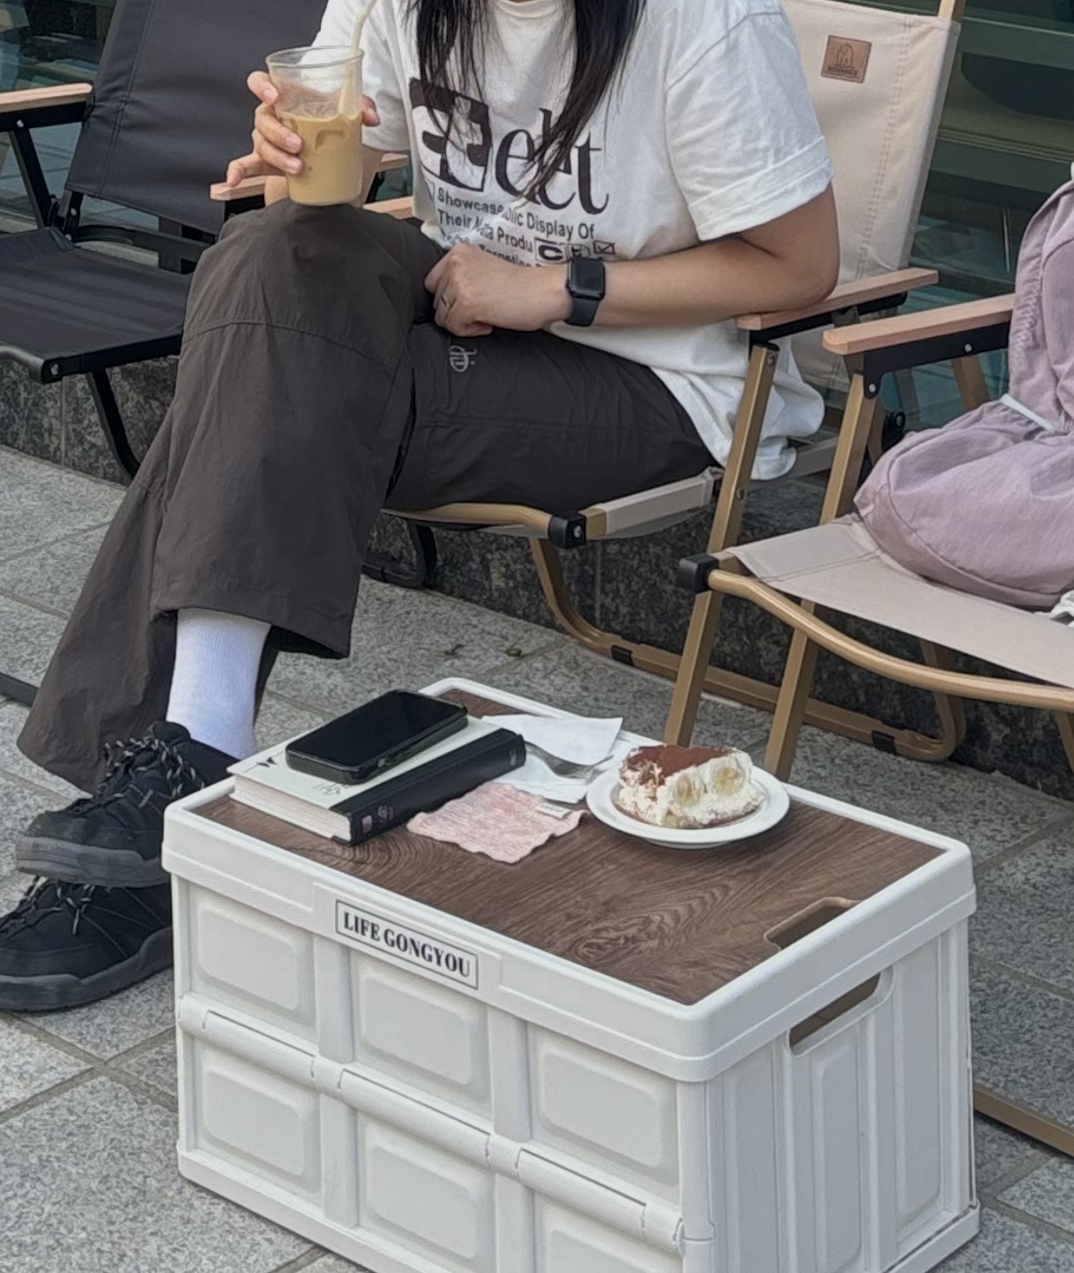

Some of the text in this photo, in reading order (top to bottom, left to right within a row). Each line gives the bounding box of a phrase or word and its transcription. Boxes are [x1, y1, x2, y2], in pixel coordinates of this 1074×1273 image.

[437, 208, 472, 229] Their
[527, 211, 574, 241] Display
[578, 222, 595, 239] Of
[344, 911, 470, 978] LIFE GONGYOU
